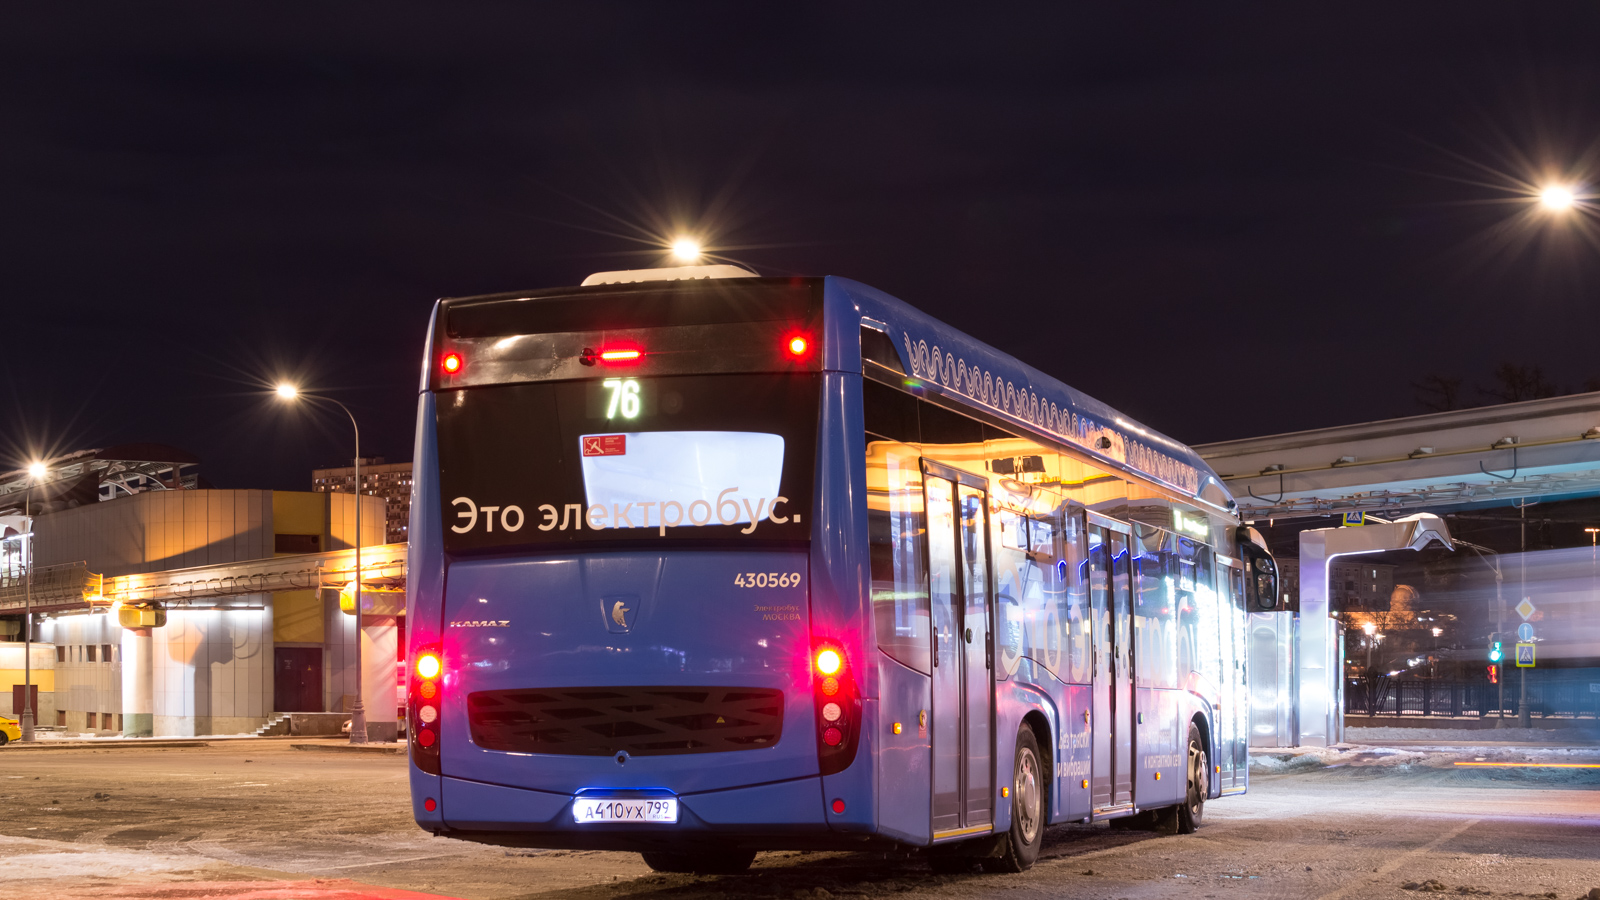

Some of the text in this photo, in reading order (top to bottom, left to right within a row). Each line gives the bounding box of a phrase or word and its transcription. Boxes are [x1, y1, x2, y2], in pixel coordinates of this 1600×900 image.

[603, 380, 640, 419] 76
[450, 486, 801, 537] Это электробус.
[734, 572, 801, 588] 430569
[754, 604, 800, 613] Электробус
[762, 613, 801, 621] МОСКВА
[1001, 560, 1061, 682] Это
[646, 801, 670, 814] 799
